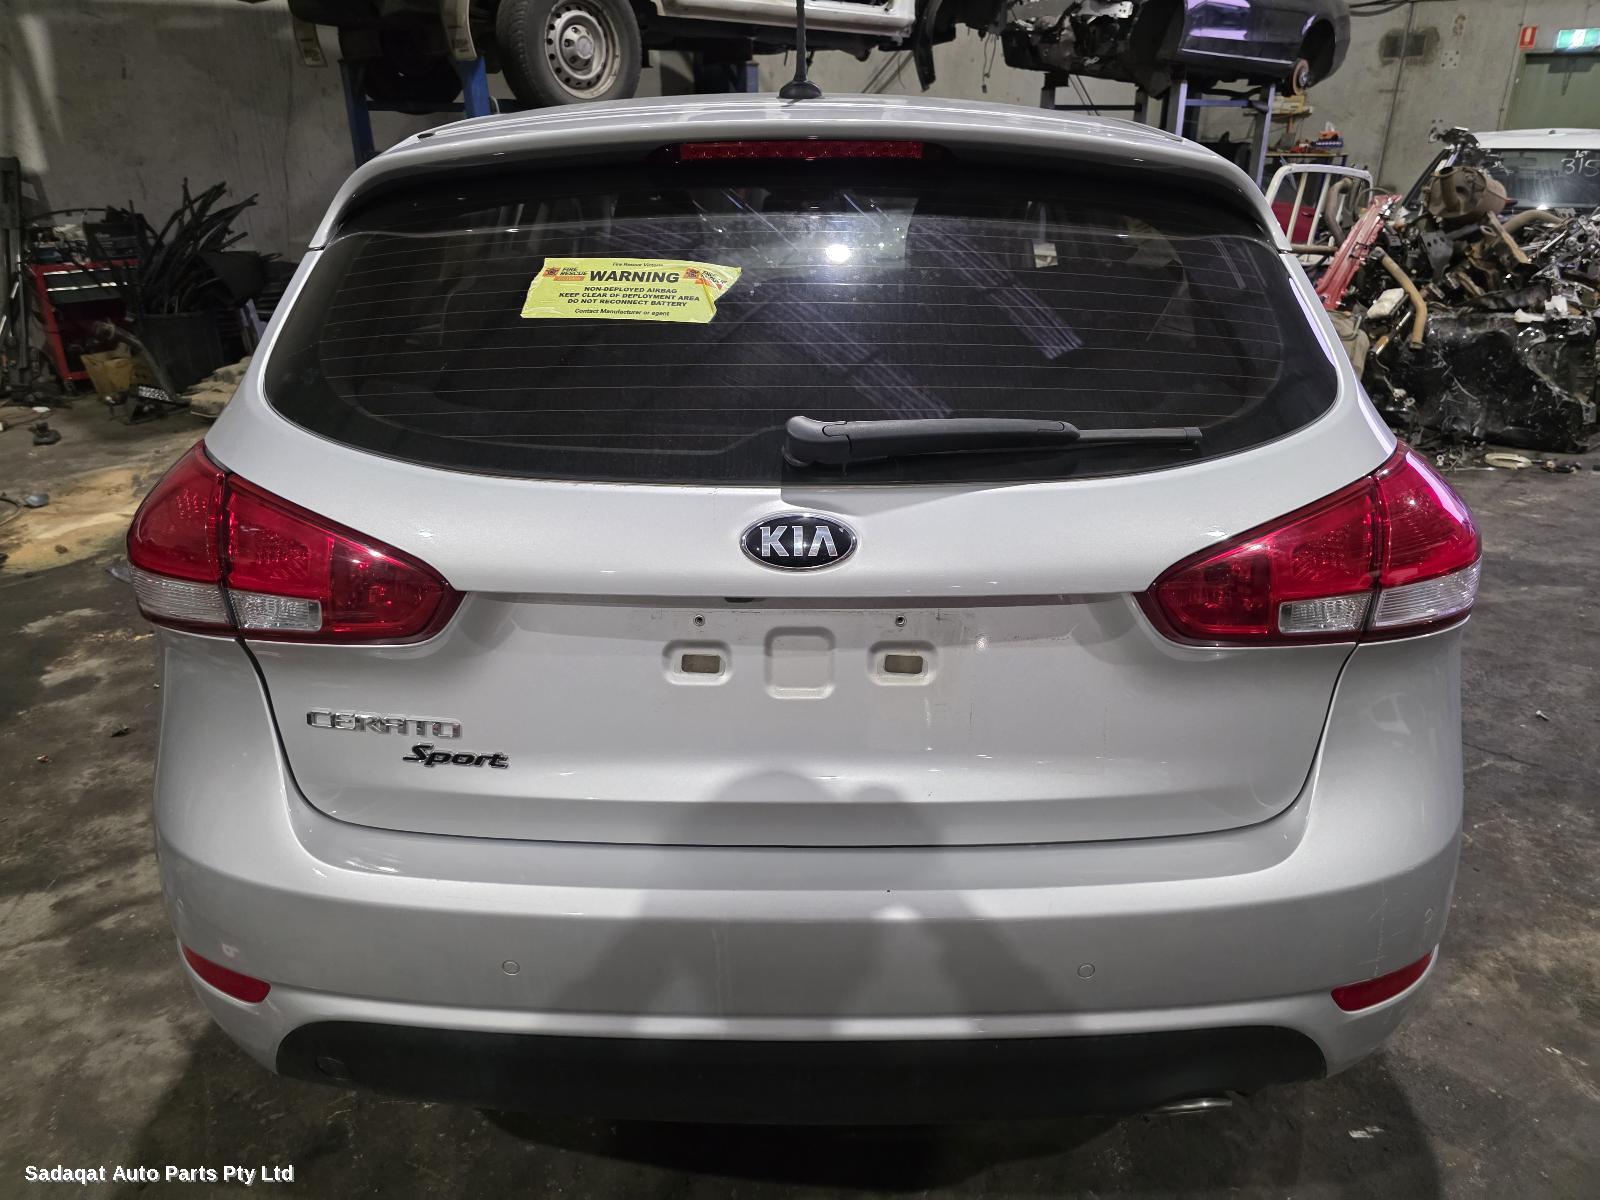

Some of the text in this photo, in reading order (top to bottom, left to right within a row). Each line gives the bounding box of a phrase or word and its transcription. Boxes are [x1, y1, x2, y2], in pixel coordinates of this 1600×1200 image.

[590, 270, 680, 283] WARNING
[760, 525, 838, 557] KIA
[306, 708, 462, 738] CERATO
[402, 741, 509, 769] Sport
